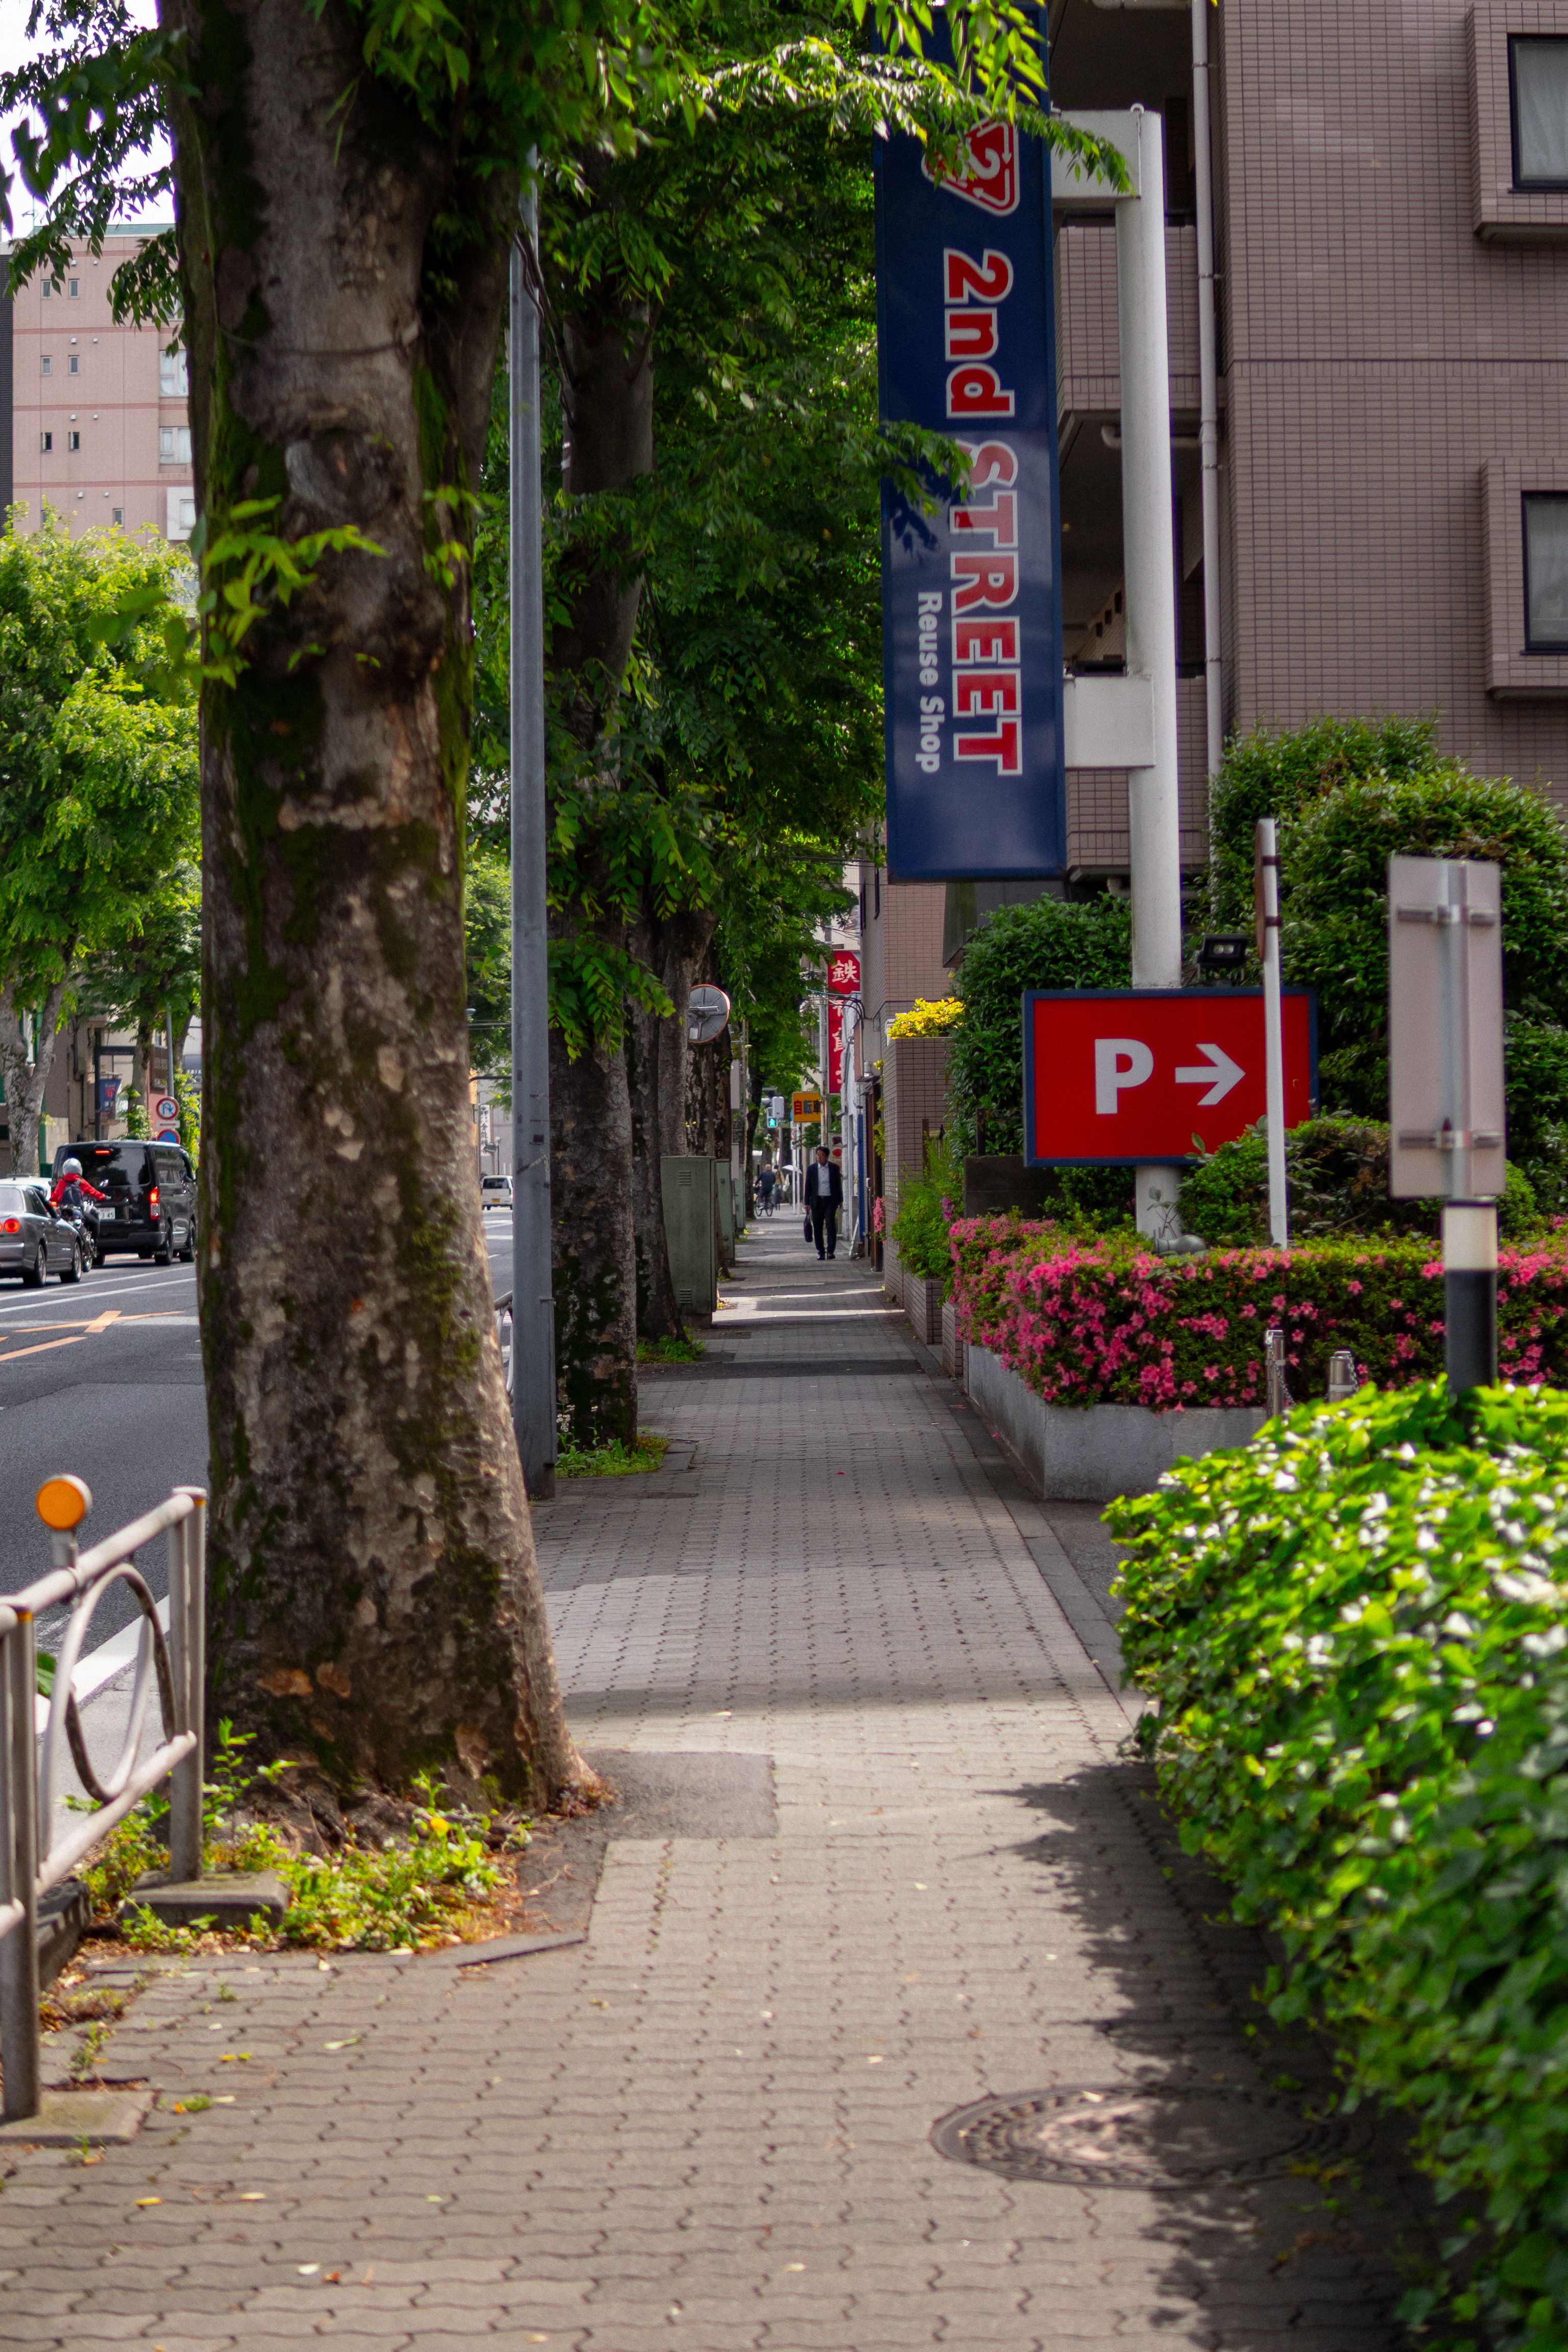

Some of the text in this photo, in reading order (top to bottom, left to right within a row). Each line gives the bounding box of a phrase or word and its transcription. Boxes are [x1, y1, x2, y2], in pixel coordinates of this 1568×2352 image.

[944, 247, 1022, 776] 2nd STREET
[915, 591, 945, 774] Reuse Shop
[830, 959, 860, 983] 鉄
[793, 1099, 822, 1115] 自転車
[1095, 1038, 1154, 1115] P
